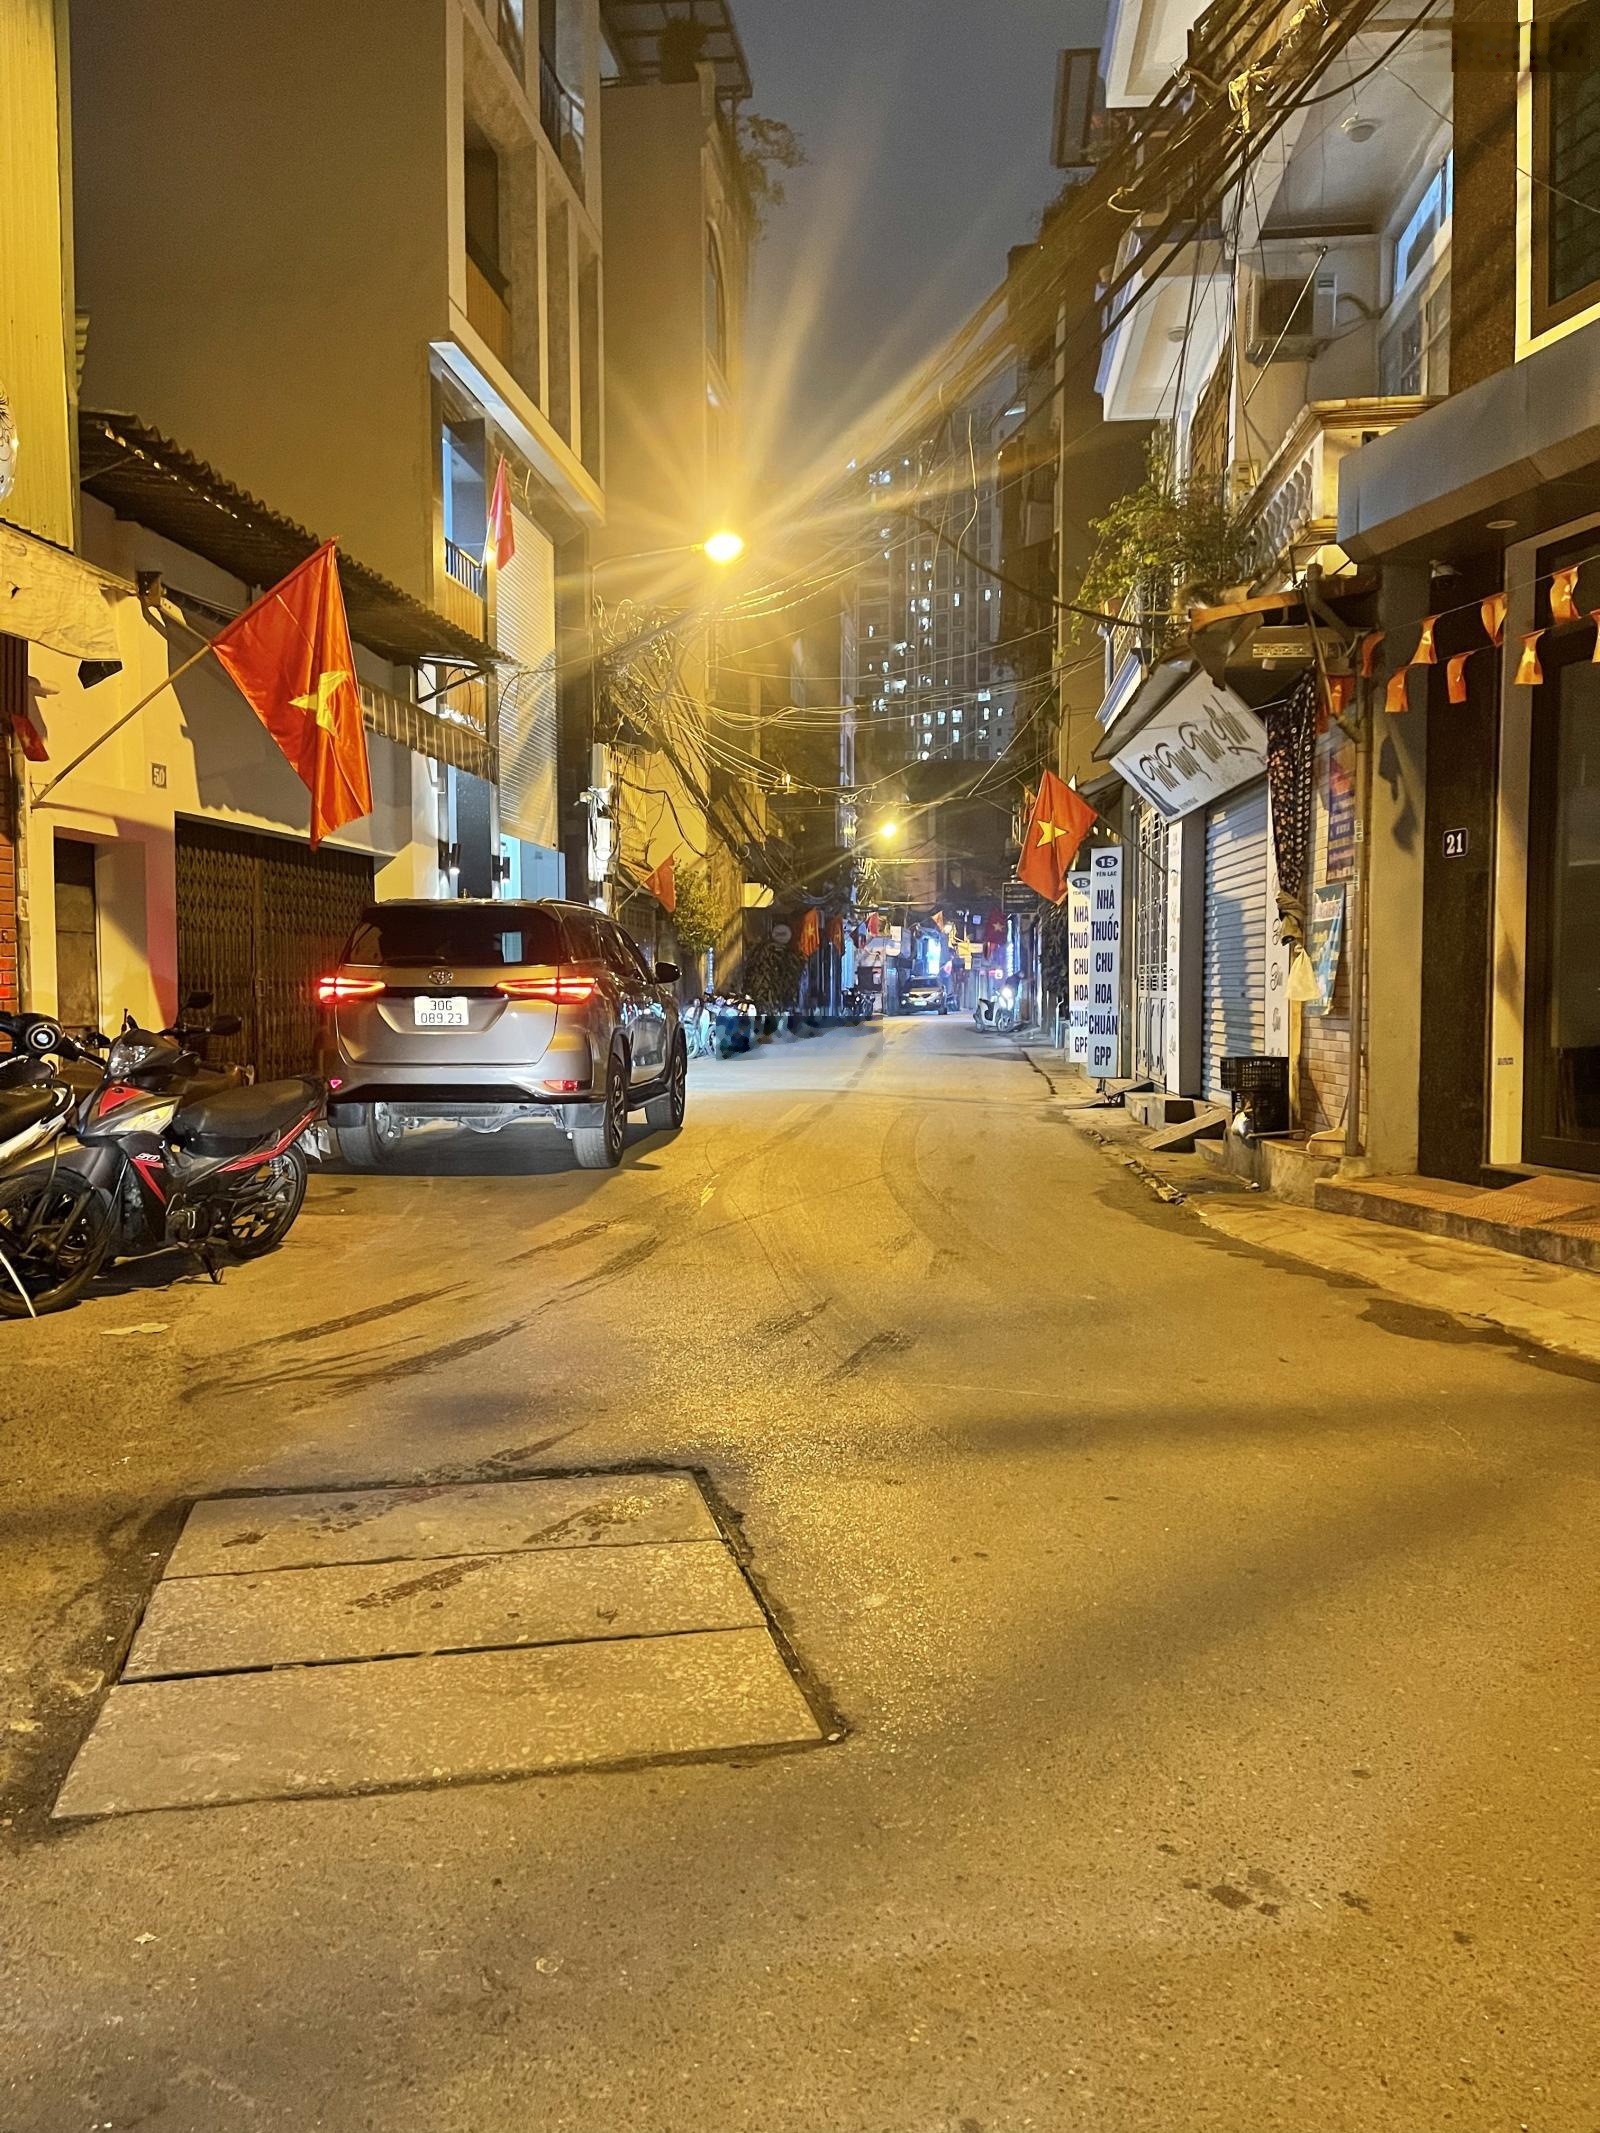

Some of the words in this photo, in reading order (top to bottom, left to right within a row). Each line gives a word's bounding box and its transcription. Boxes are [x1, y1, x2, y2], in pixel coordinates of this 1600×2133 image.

[1446, 832, 1463, 854] 21
[1098, 857, 1116, 868] 15
[1096, 884, 1115, 910] NHÀ
[1073, 902, 1089, 922] NHÀ
[1070, 926, 1088, 949] THUỐ
[1091, 913, 1119, 941] THUỐC
[1074, 958, 1089, 975] CHU
[1095, 951, 1113, 973] CHU
[1074, 984, 1089, 1001] HOA
[1094, 983, 1112, 1004] HOA
[429, 999, 453, 1011] 30G
[420, 1012, 462, 1024] 089.23
[1088, 1006, 1118, 1035] CHUẨN
[1094, 1045, 1112, 1066] GPP
